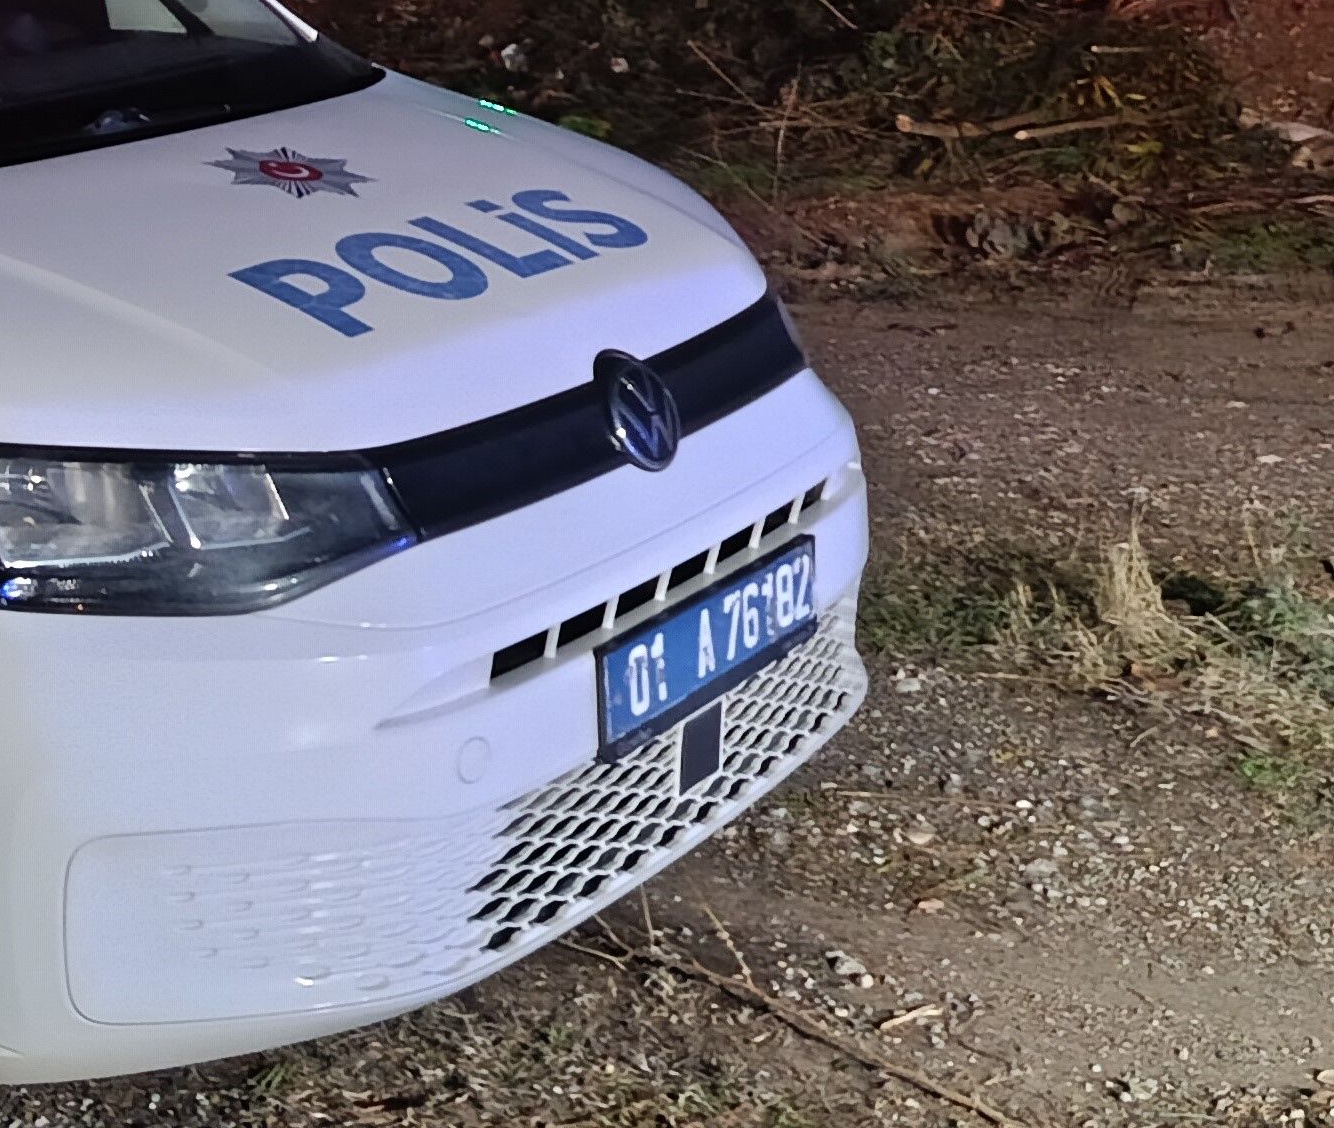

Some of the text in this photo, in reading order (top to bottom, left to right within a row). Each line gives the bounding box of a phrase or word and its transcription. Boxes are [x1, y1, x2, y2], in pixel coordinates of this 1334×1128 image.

[628, 554, 811, 716] 01 A 76182
